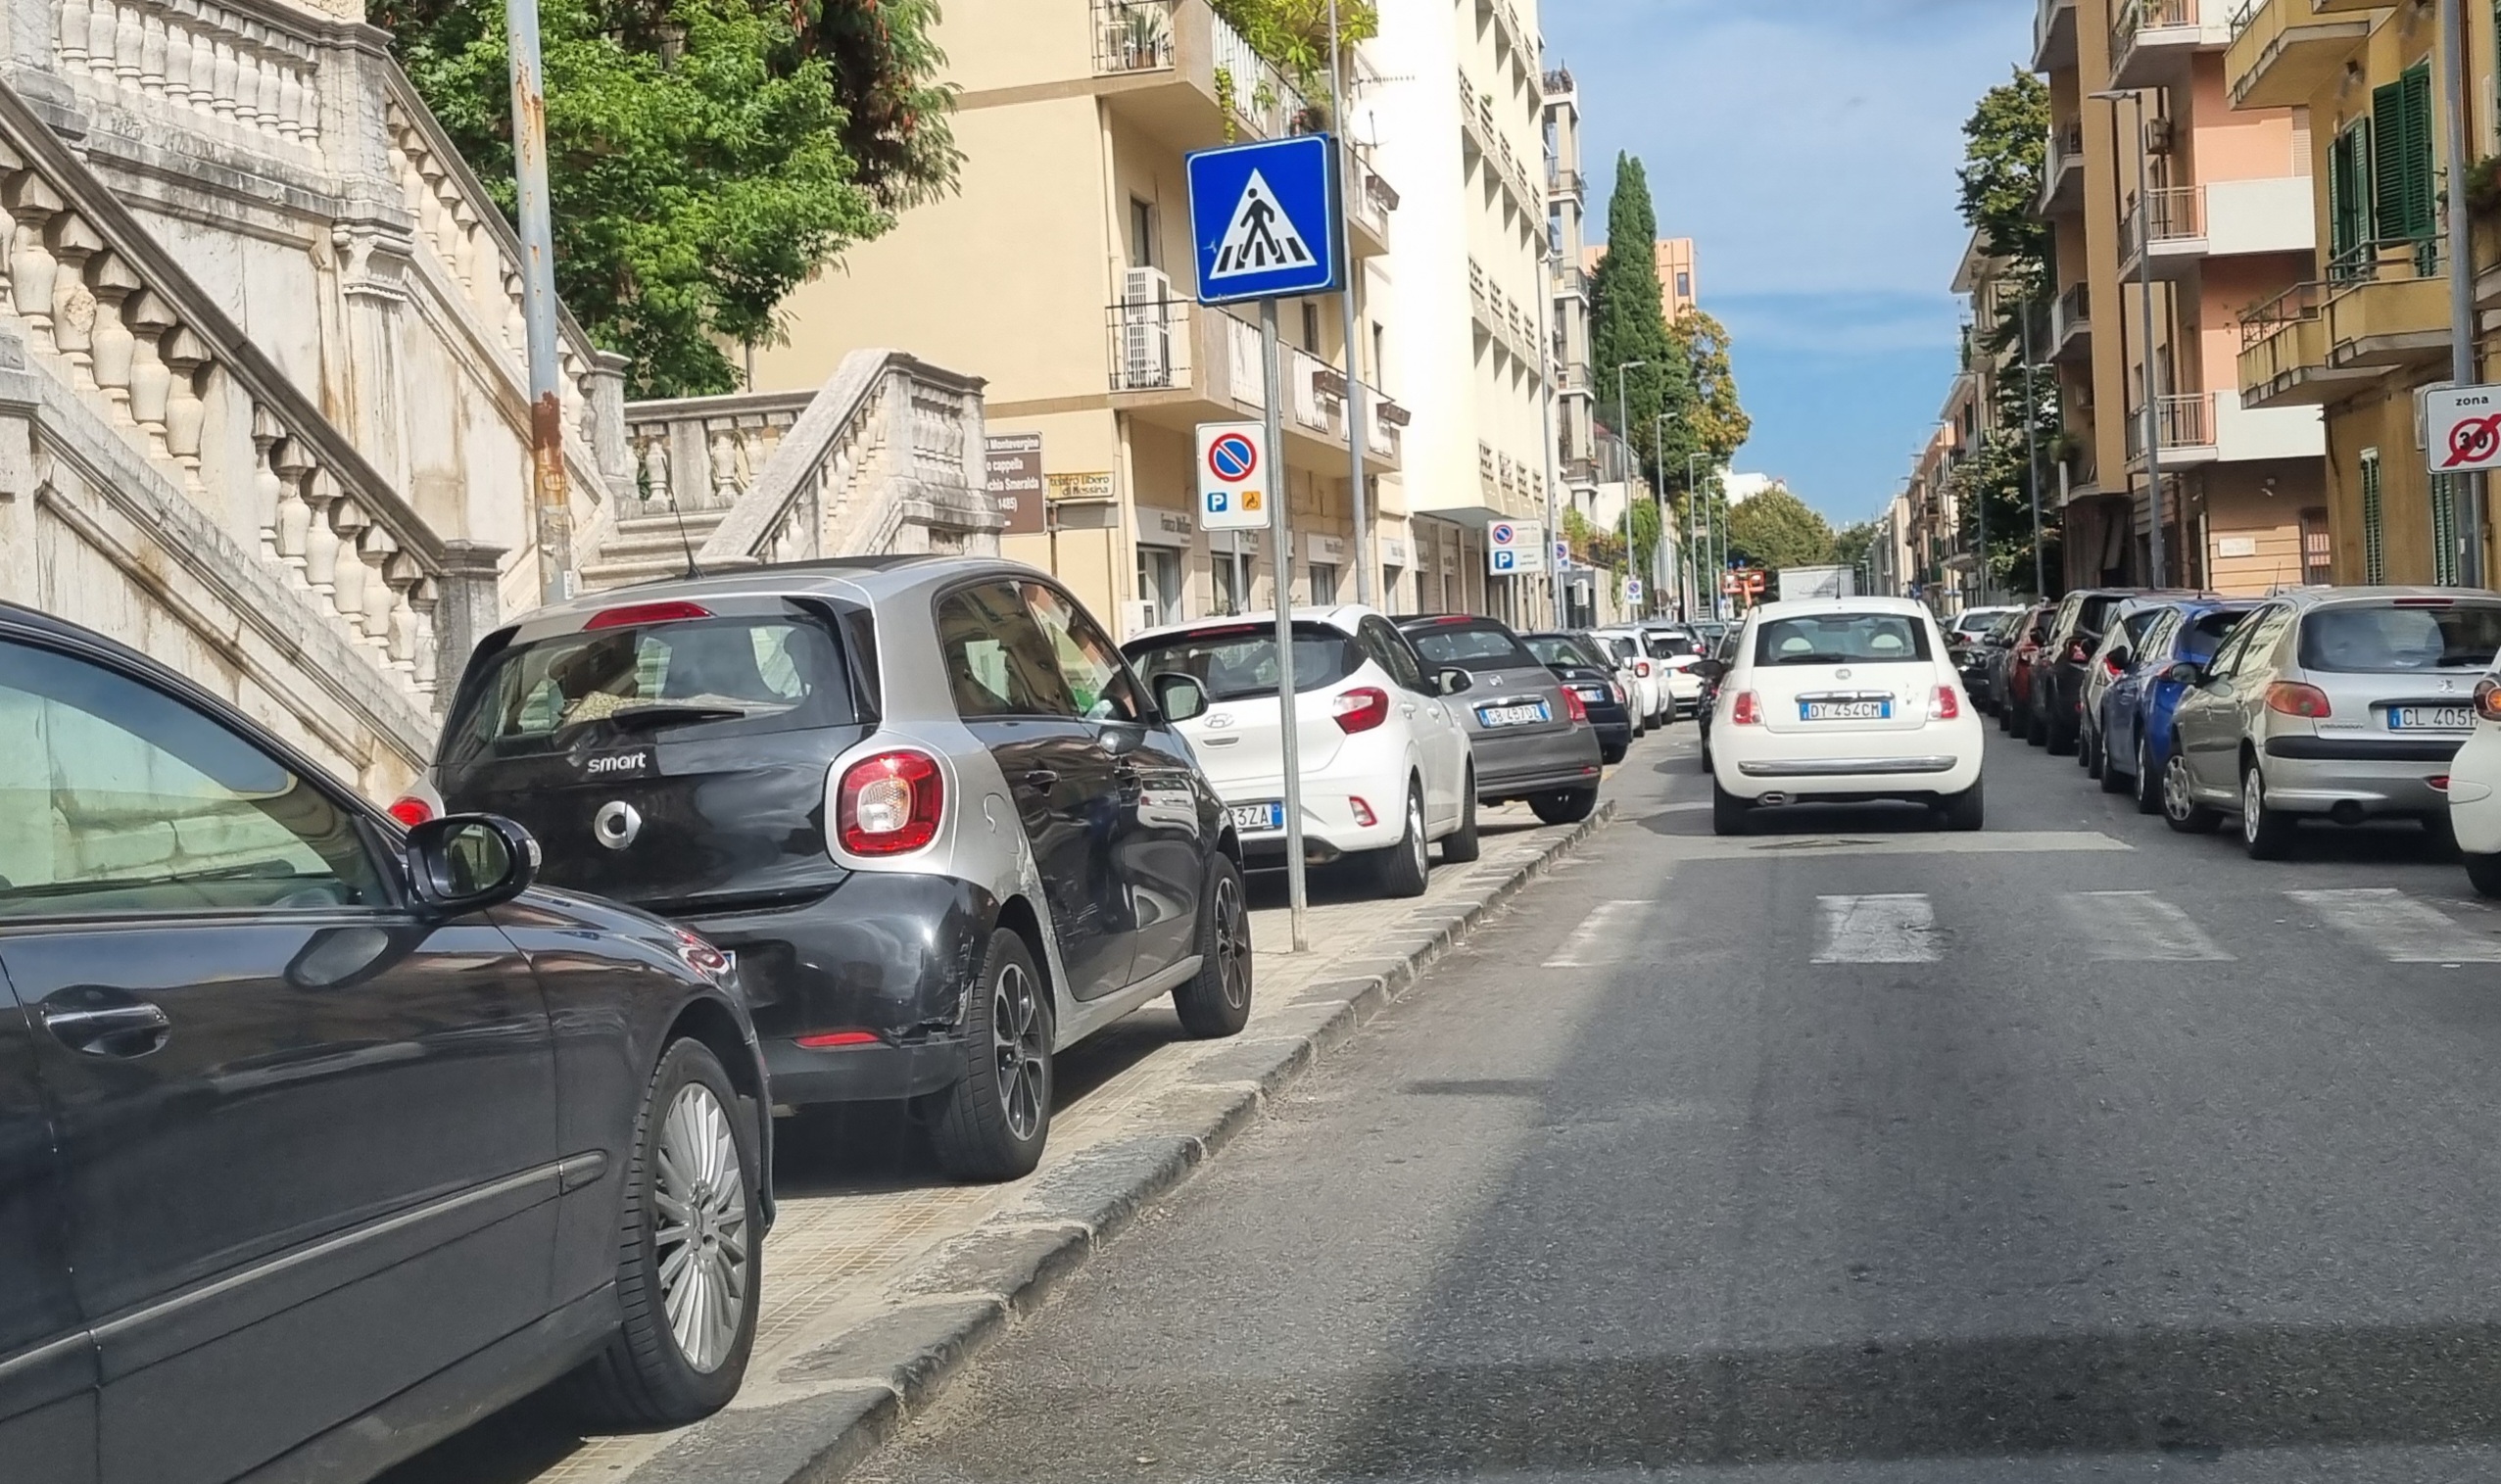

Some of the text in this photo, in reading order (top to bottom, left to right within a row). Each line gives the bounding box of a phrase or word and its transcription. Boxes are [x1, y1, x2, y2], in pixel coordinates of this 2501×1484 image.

[2455, 396, 2489, 407] zona
[989, 437, 1039, 451] Montevergine
[2459, 431, 2488, 450] 30
[992, 456, 1024, 474] cappella
[1004, 476, 1040, 491] Smeralda
[1073, 485, 1109, 496] Messina
[1211, 494, 1225, 511] P
[1498, 551, 1512, 568] P
[1810, 703, 1880, 718] DY 454CM
[2403, 709, 2426, 727] CL
[588, 751, 647, 774] smart
